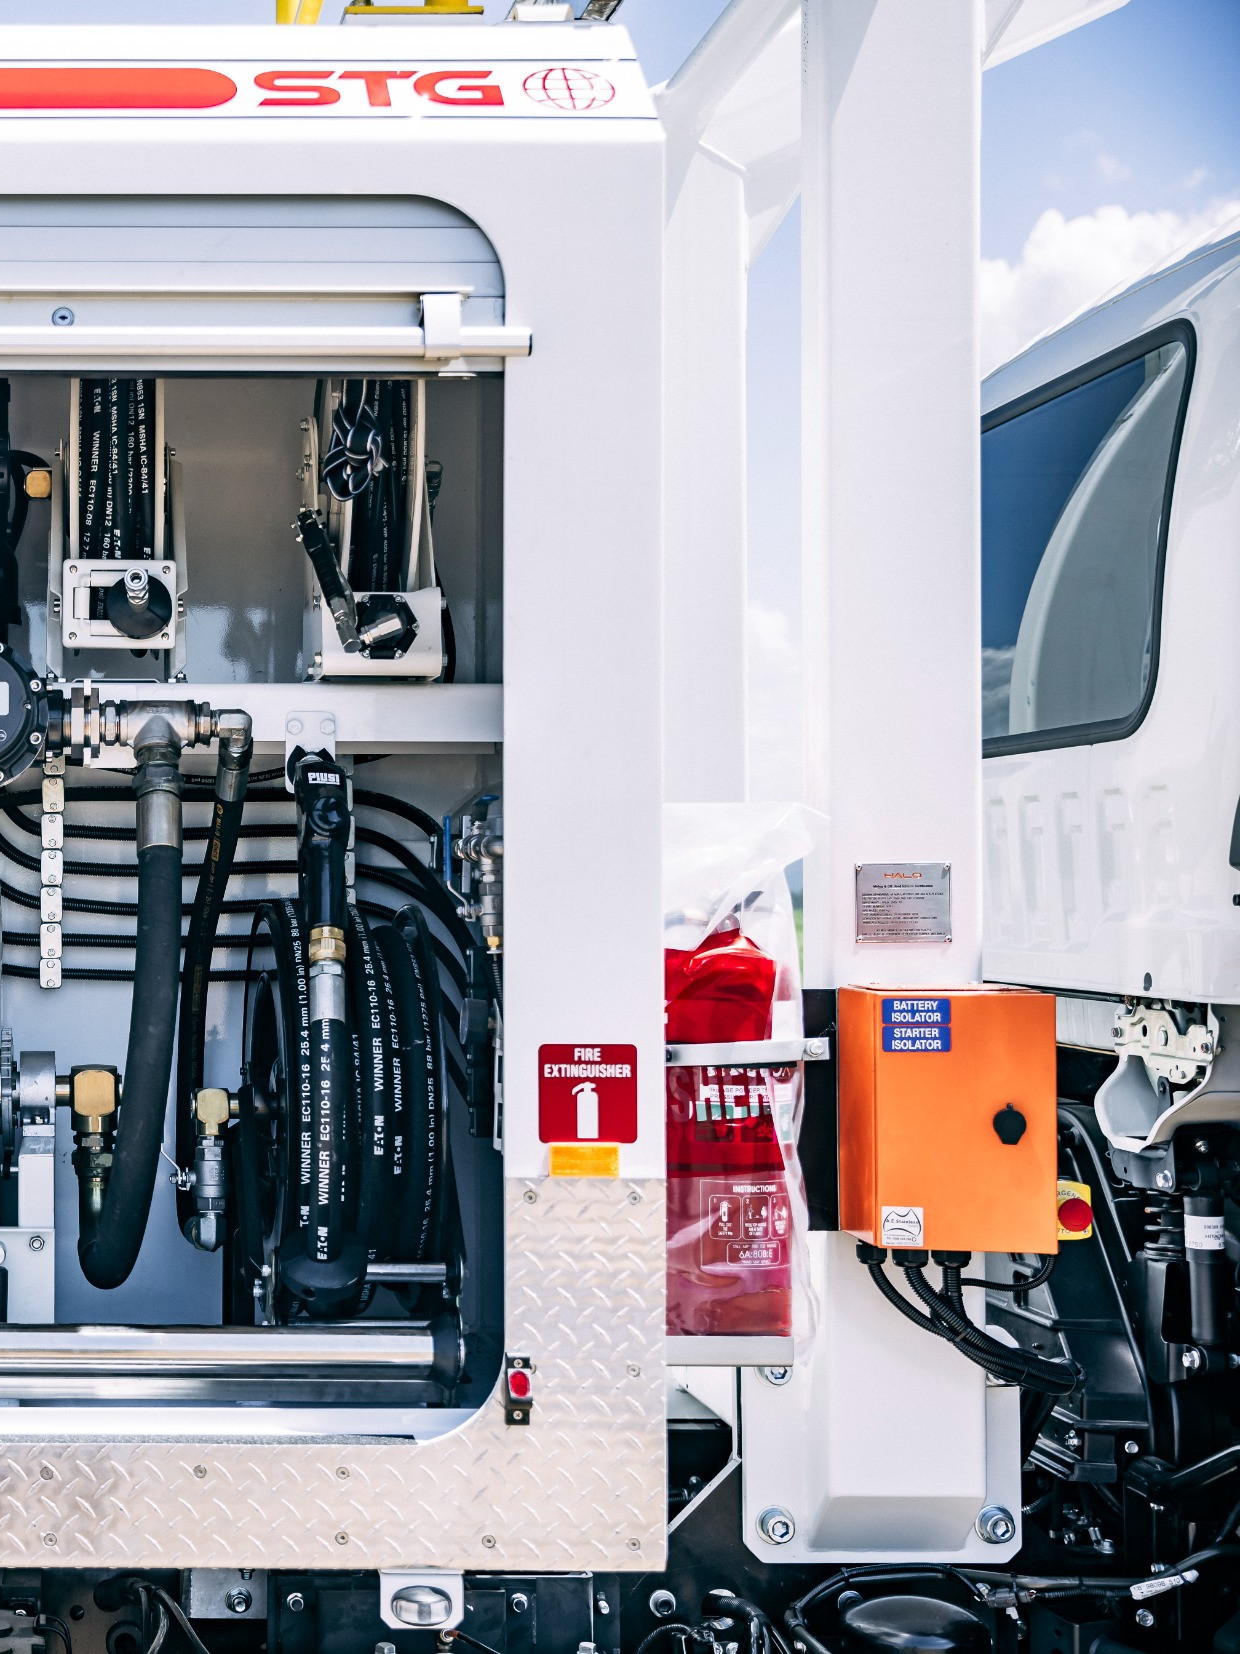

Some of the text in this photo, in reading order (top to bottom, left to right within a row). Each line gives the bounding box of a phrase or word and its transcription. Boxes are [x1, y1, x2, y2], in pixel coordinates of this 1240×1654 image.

[254, 70, 504, 107] STG
[91, 430, 101, 472] WINNER
[139, 424, 148, 453] MSHA
[141, 455, 150, 494] IC-84/41
[301, 1006, 309, 1027] mm
[367, 979, 381, 1029] EC110-16
[891, 1012, 941, 1022] ISOLATOR
[893, 1000, 939, 1011] BATTERY
[320, 1018, 330, 1040] mm
[387, 998, 399, 1049] EC110-16
[893, 1028, 939, 1038] STARTER
[300, 1029, 310, 1056] 25.4
[573, 1048, 602, 1062] FIRE
[891, 1040, 942, 1050] ISOLATOR
[372, 1037, 384, 1092] WINNER
[543, 1064, 632, 1078] EXTINGUISHER
[301, 1063, 311, 1122] EC110-16
[392, 1057, 402, 1112] WINNER
[320, 1080, 331, 1141] EC110-16
[300, 1131, 311, 1185] WINNER
[318, 1150, 330, 1205] WINNER
[732, 1184, 777, 1193] INSTRUCTIONS
